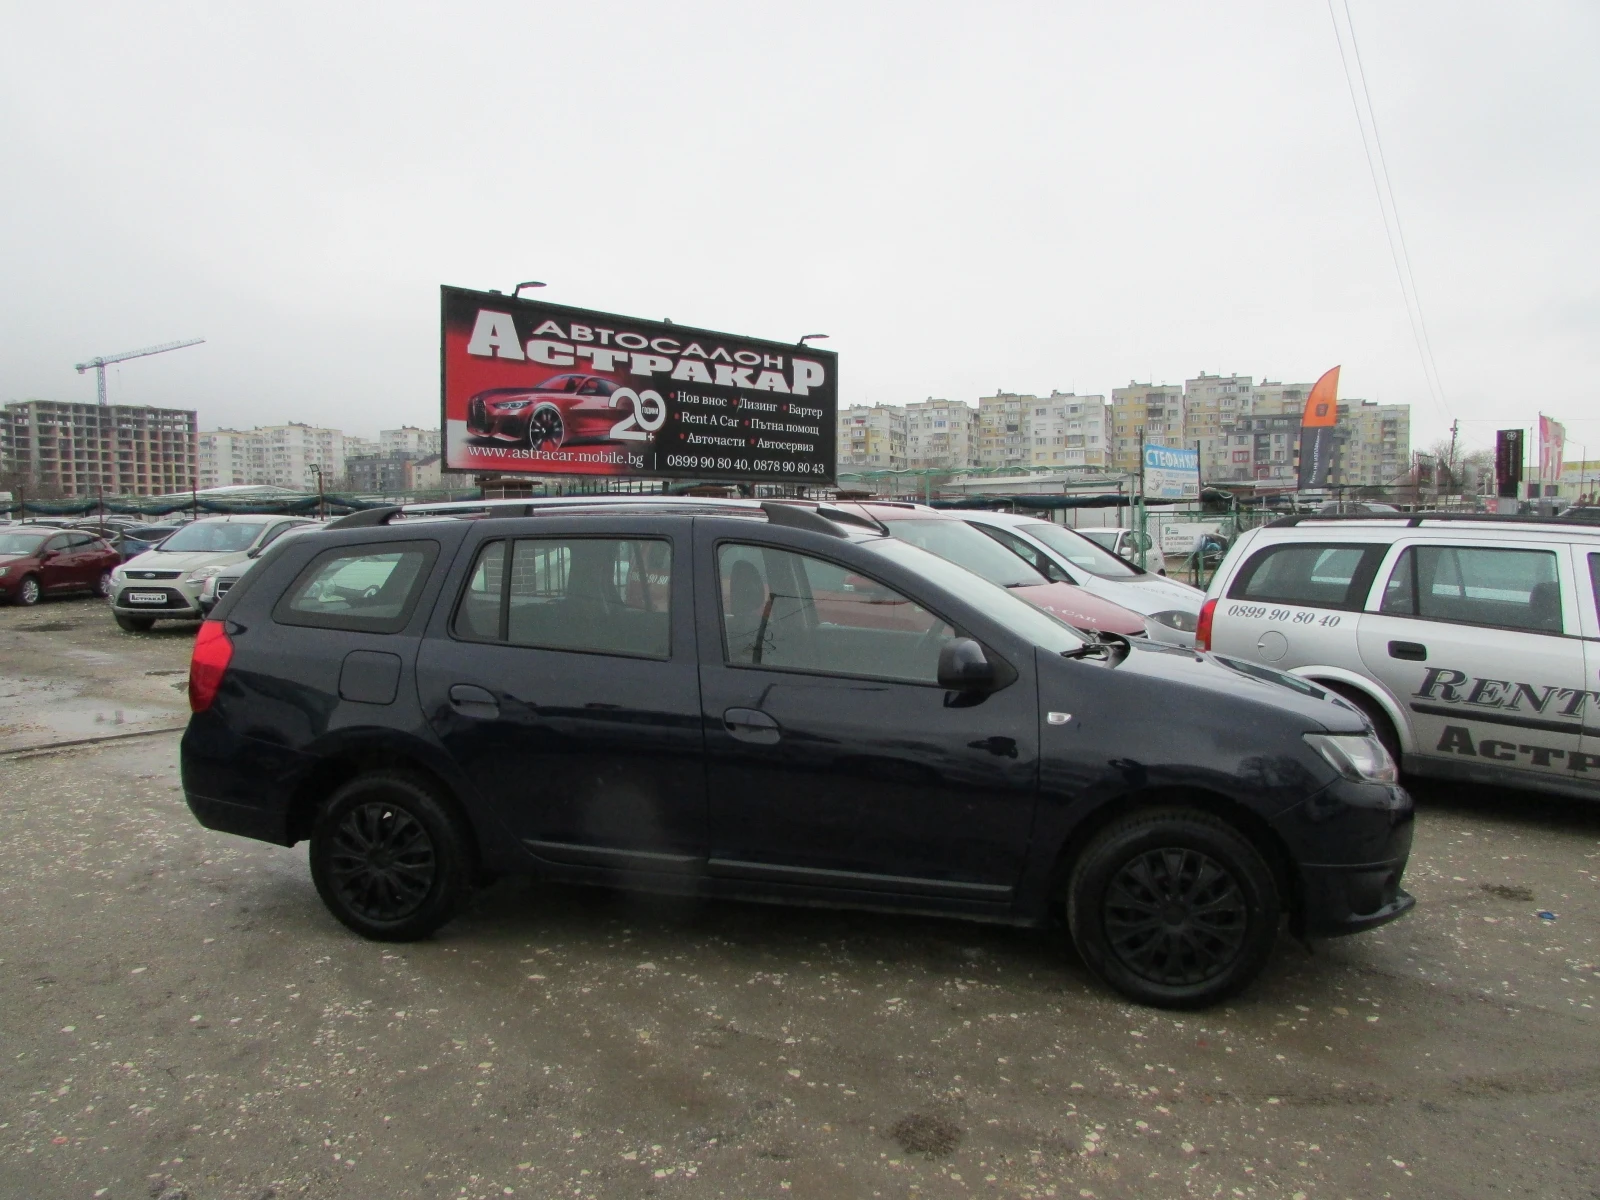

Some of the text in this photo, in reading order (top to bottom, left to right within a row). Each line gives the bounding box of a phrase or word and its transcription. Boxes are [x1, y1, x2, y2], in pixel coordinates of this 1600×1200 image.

[467, 309, 825, 396] АСТРАКАР
[532, 320, 784, 370] АВТОСАЛОН
[677, 391, 727, 407] Нов внос
[738, 398, 778, 412] Лизинг
[682, 412, 739, 427] Rent A Car
[789, 404, 823, 420] Бартер
[751, 419, 820, 436] Пътна помощ
[687, 433, 746, 447] Авточасти
[757, 438, 814, 453] Автосервиз
[467, 445, 644, 468] www.astracar.mobile.bg
[667, 455, 825, 475] 0899 90 80 40, 0878 90 80 43
[1228, 604, 1341, 627] 0899 90 80 40
[1411, 667, 1600, 719] RENT
